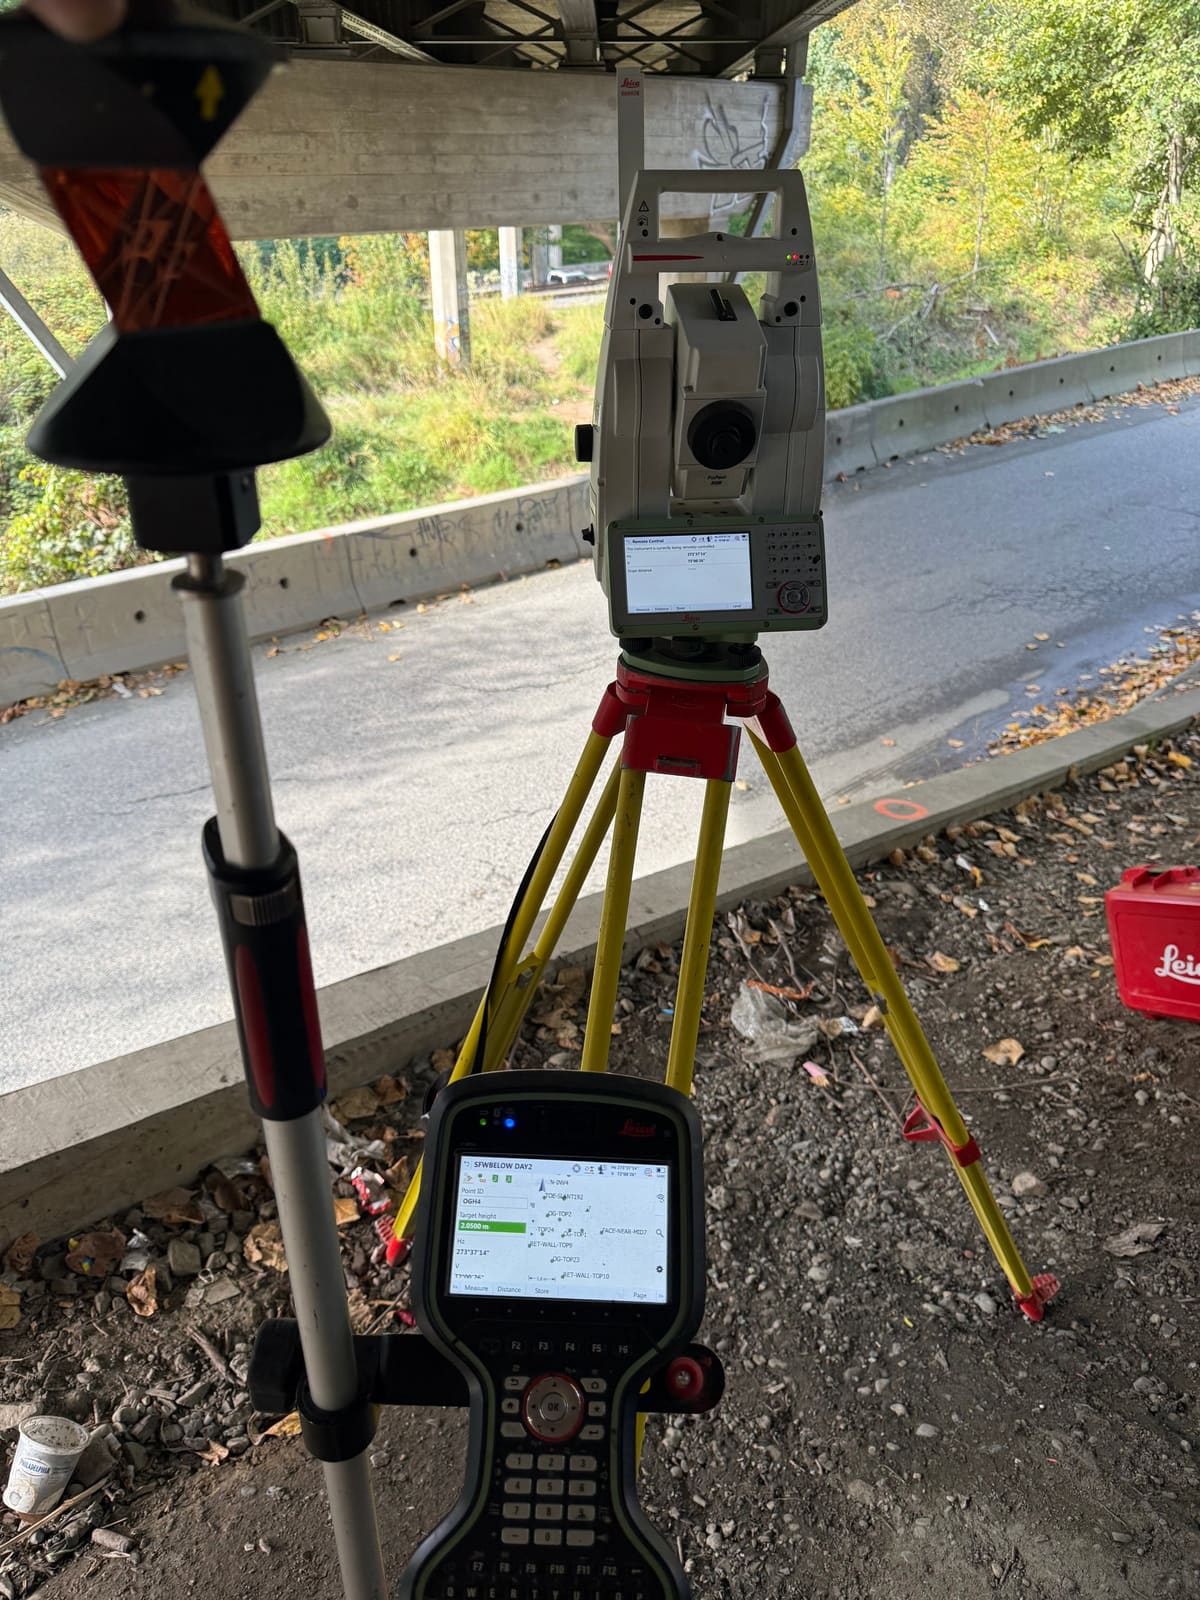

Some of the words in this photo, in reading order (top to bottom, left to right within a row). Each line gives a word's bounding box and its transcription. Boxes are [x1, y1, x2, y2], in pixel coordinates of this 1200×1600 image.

[620, 78, 640, 88] Leica
[473, 1161, 513, 1169] SFWBELOW
[460, 1211, 478, 1220] Target
[460, 1222, 481, 1230] 2.0500
[633, 1291, 647, 1299] Page
[511, 1341, 521, 1350] F2
[538, 1341, 549, 1351] F3
[565, 1342, 575, 1352] F4
[592, 1343, 602, 1353] F5
[618, 1344, 629, 1354] F6
[547, 1402, 559, 1411] OK
[20, 1458, 51, 1474] PHILADELPHIA
[472, 1561, 484, 1572] F7
[499, 1562, 510, 1573] F8
[525, 1563, 536, 1573] F9
[549, 1563, 565, 1574] F10
[576, 1564, 591, 1575] F11
[602, 1565, 617, 1576] F12
[447, 1586, 454, 1597] Q
[466, 1587, 477, 1598] W
[489, 1588, 496, 1599] E
[510, 1588, 517, 1600] R
[532, 1589, 539, 1600] T
